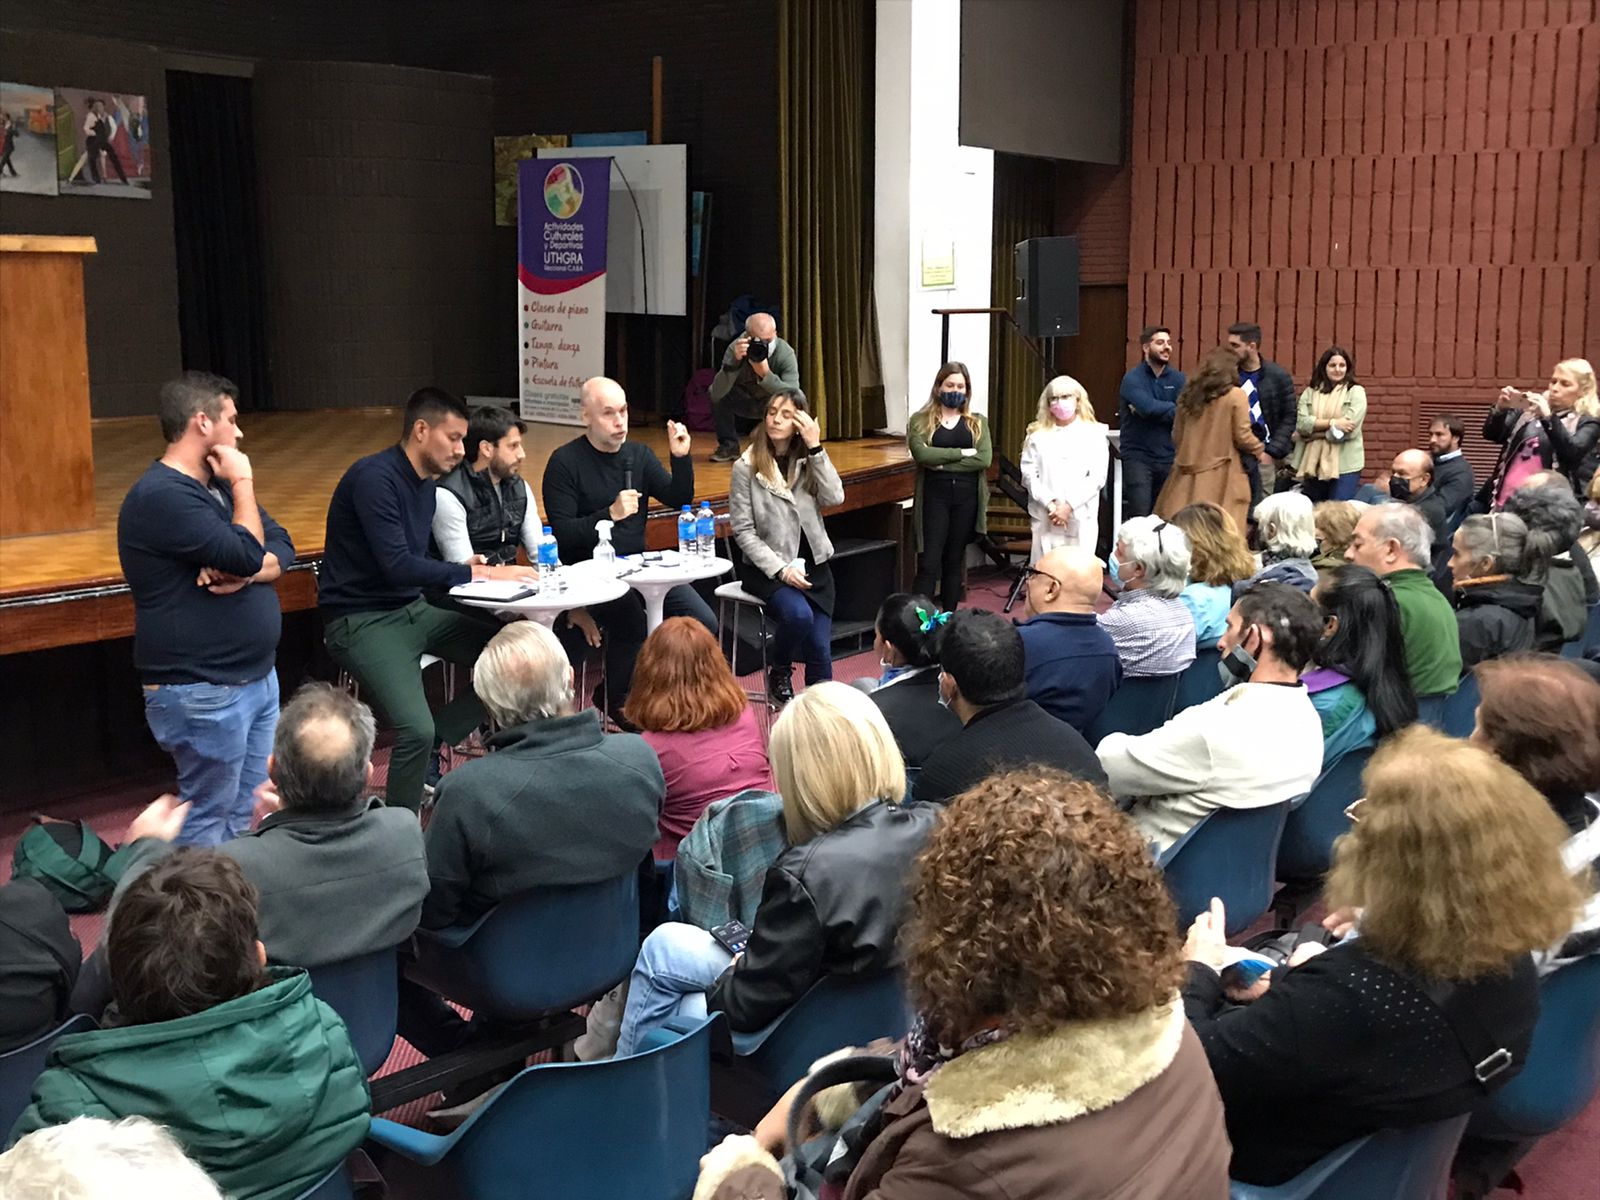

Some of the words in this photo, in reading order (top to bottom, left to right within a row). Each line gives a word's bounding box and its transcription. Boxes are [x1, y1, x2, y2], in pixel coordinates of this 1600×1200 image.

[543, 222, 584, 231] Actividades
[543, 230, 584, 241] Culturales
[549, 240, 584, 250] Deportivas
[543, 251, 584, 265] UTHGRA
[531, 301, 555, 312] Clases
[557, 301, 566, 313] de
[567, 304, 589, 319] piano
[531, 319, 563, 331] Guitarra
[557, 339, 581, 358] danza
[531, 356, 559, 370] Pintura
[532, 375, 557, 386] Escuela
[558, 375, 567, 388] de
